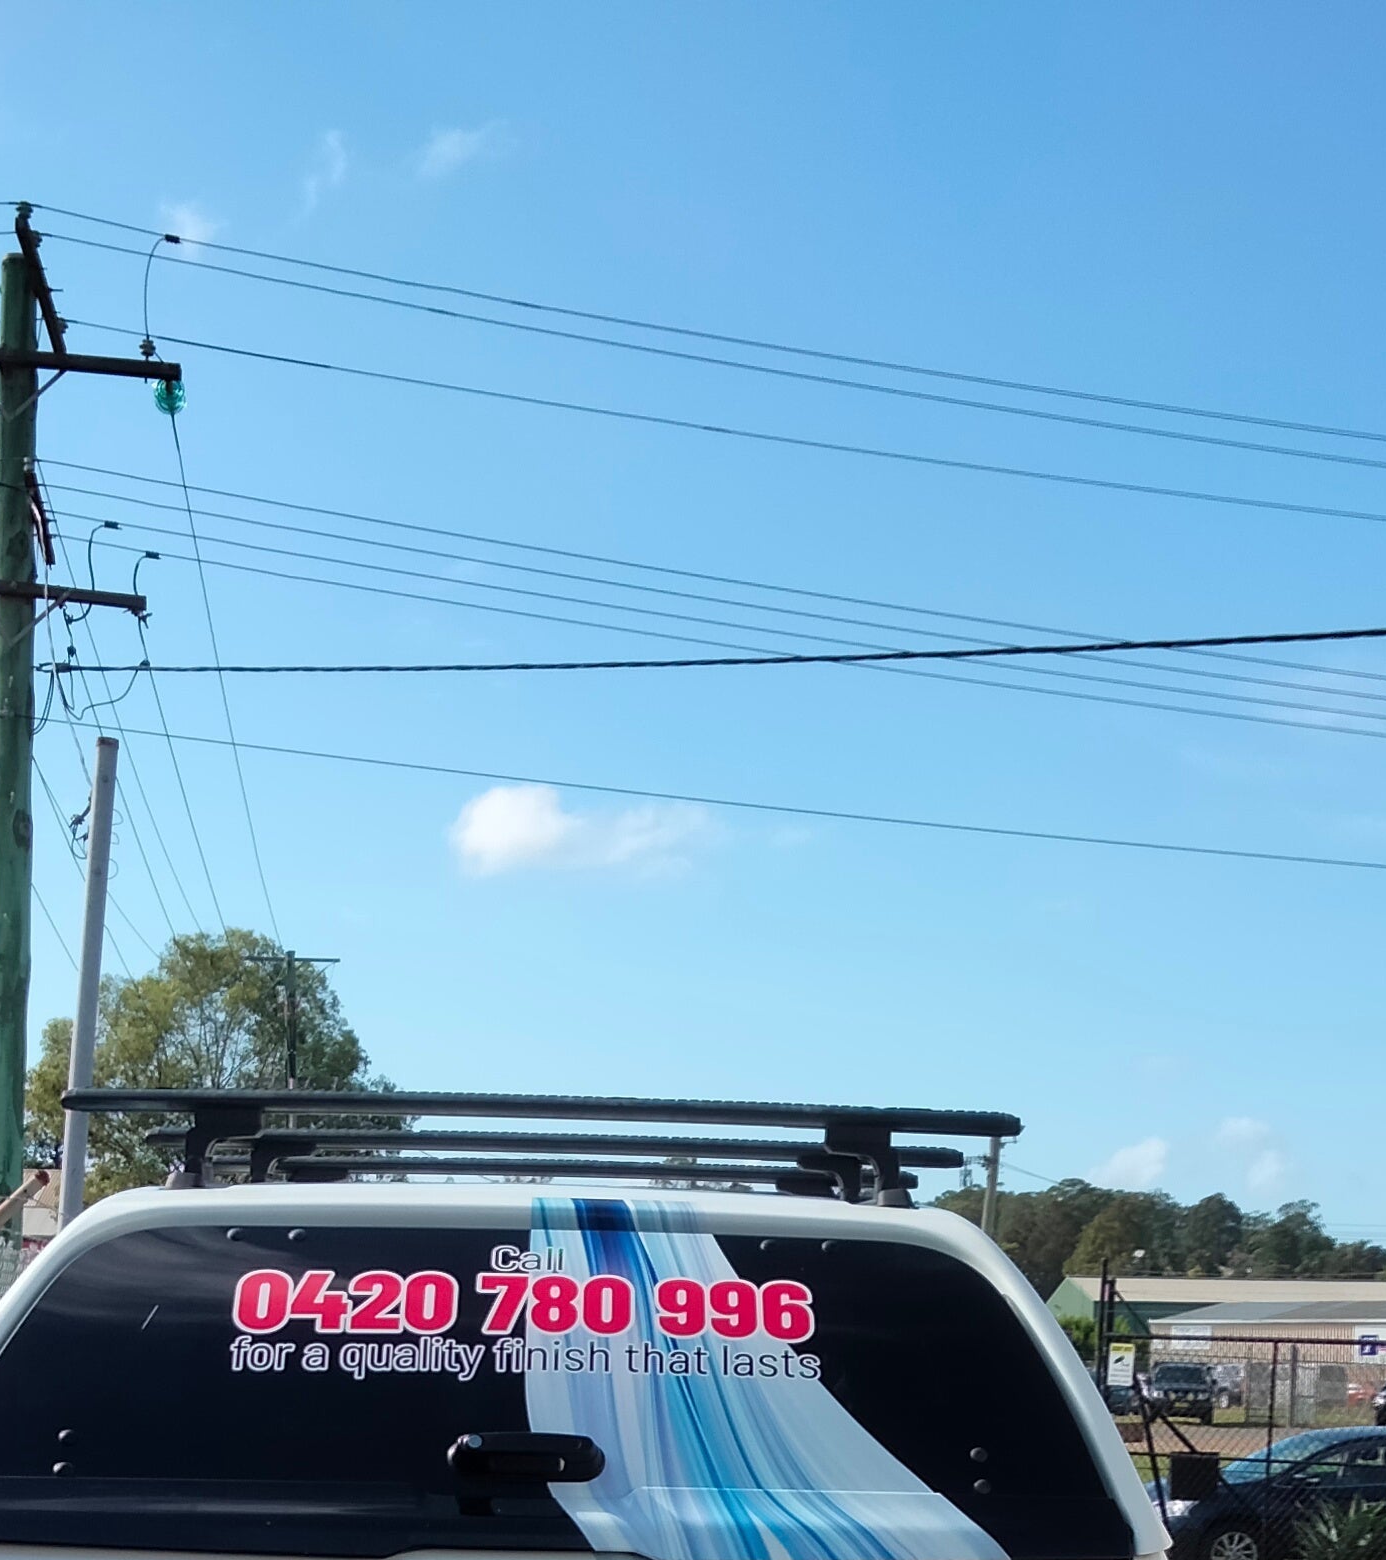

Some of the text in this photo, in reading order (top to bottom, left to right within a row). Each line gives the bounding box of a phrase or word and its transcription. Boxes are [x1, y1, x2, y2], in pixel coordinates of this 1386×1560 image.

[491, 1245, 565, 1272] Call
[232, 1268, 815, 1343] 0420 780 996
[229, 1336, 822, 1381] for a quality finish that lasts
